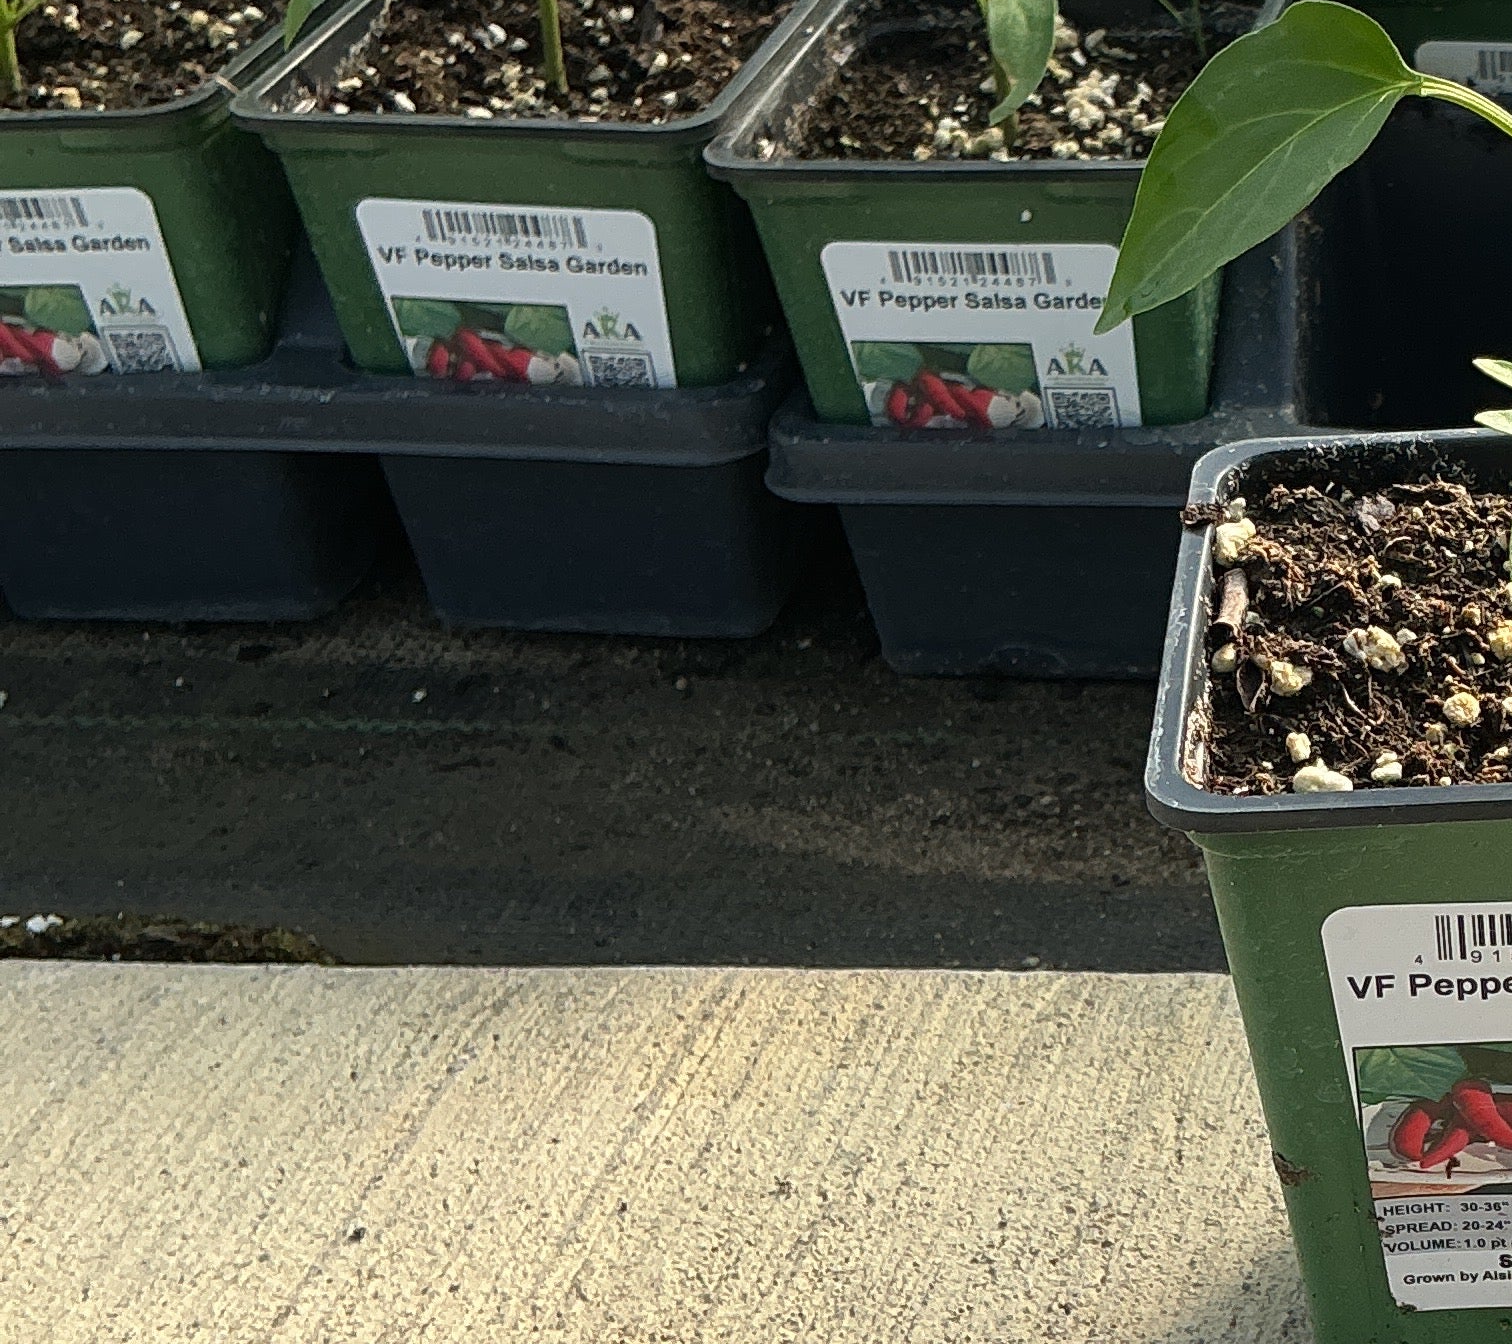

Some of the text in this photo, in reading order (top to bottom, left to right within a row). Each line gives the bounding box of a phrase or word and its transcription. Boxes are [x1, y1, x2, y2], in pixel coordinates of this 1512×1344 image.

[72, 234, 150, 252] Garden
[377, 246, 647, 276] VF Pepper Salsa Garden
[840, 289, 870, 307] VF
[879, 290, 957, 312] Pepper
[965, 292, 1027, 310] Salsa
[1414, 954, 1424, 966] 4
[1347, 975, 1396, 1000] VF
[1383, 1202, 1450, 1217] HEIGHT:
[1385, 1220, 1458, 1236] SPREAD:
[1384, 1238, 1461, 1253] VOLUME:
[1464, 1238, 1486, 1249] 1.0
[1491, 1238, 1507, 1251] pt
[1403, 1273, 1456, 1285] Grown
[1460, 1271, 1479, 1284] by
